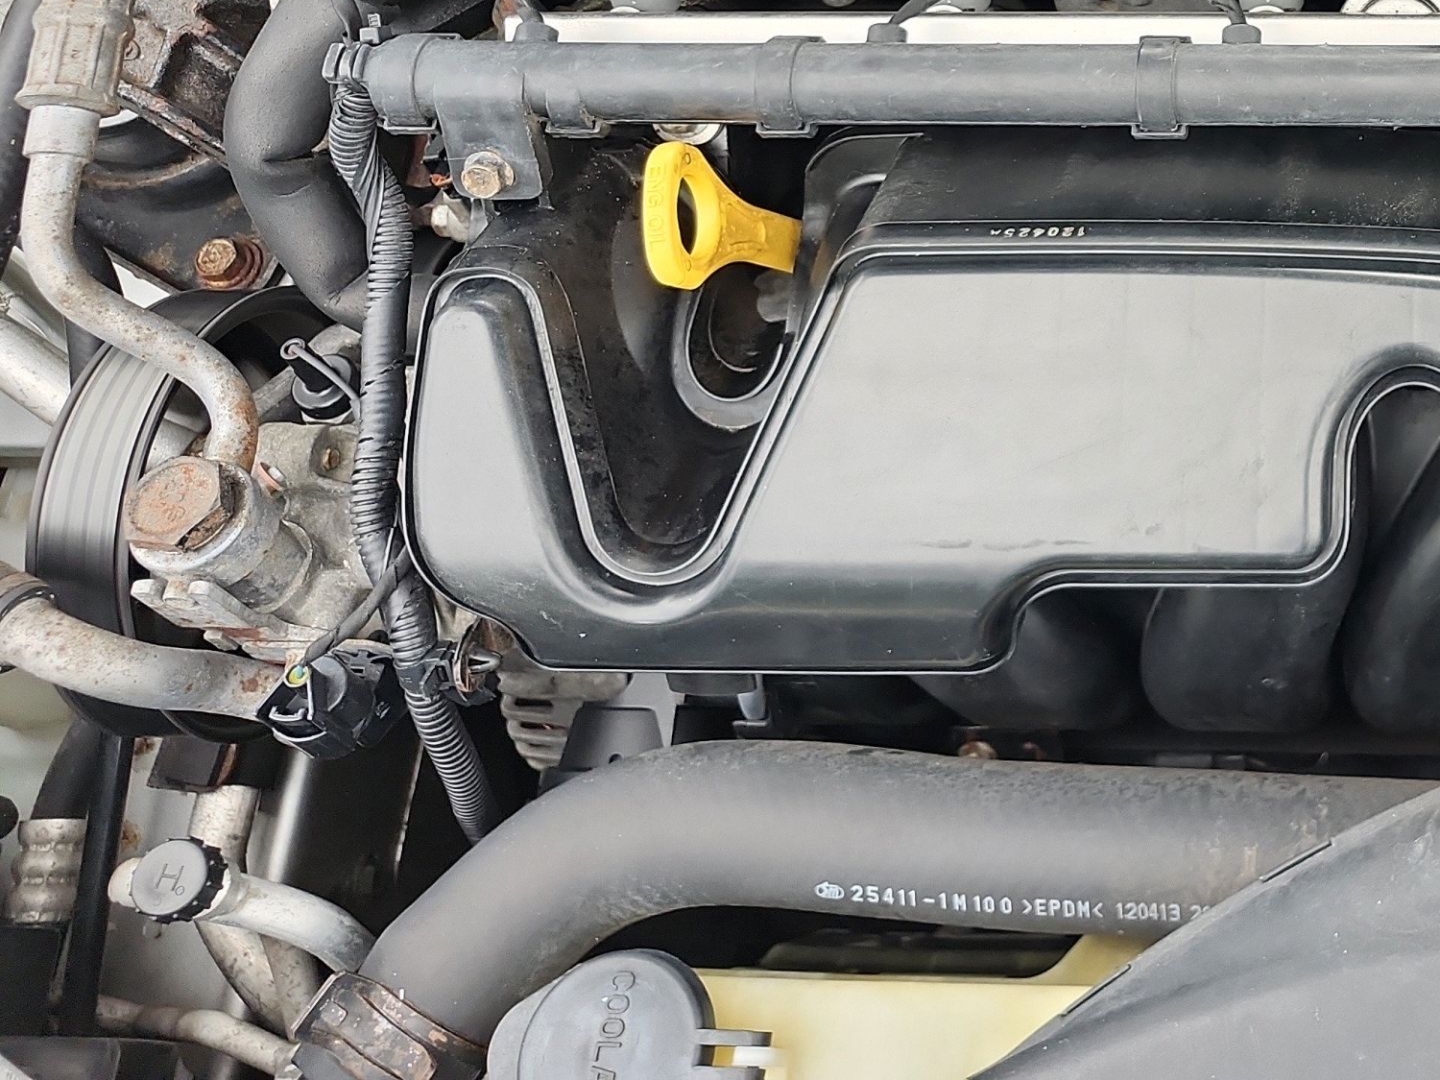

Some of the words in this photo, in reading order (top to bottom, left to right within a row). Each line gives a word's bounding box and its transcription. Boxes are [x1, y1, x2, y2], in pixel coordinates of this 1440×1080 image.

[647, 163, 667, 209] ENG
[647, 214, 668, 252] OIL
[1115, 901, 1181, 921] 120413
